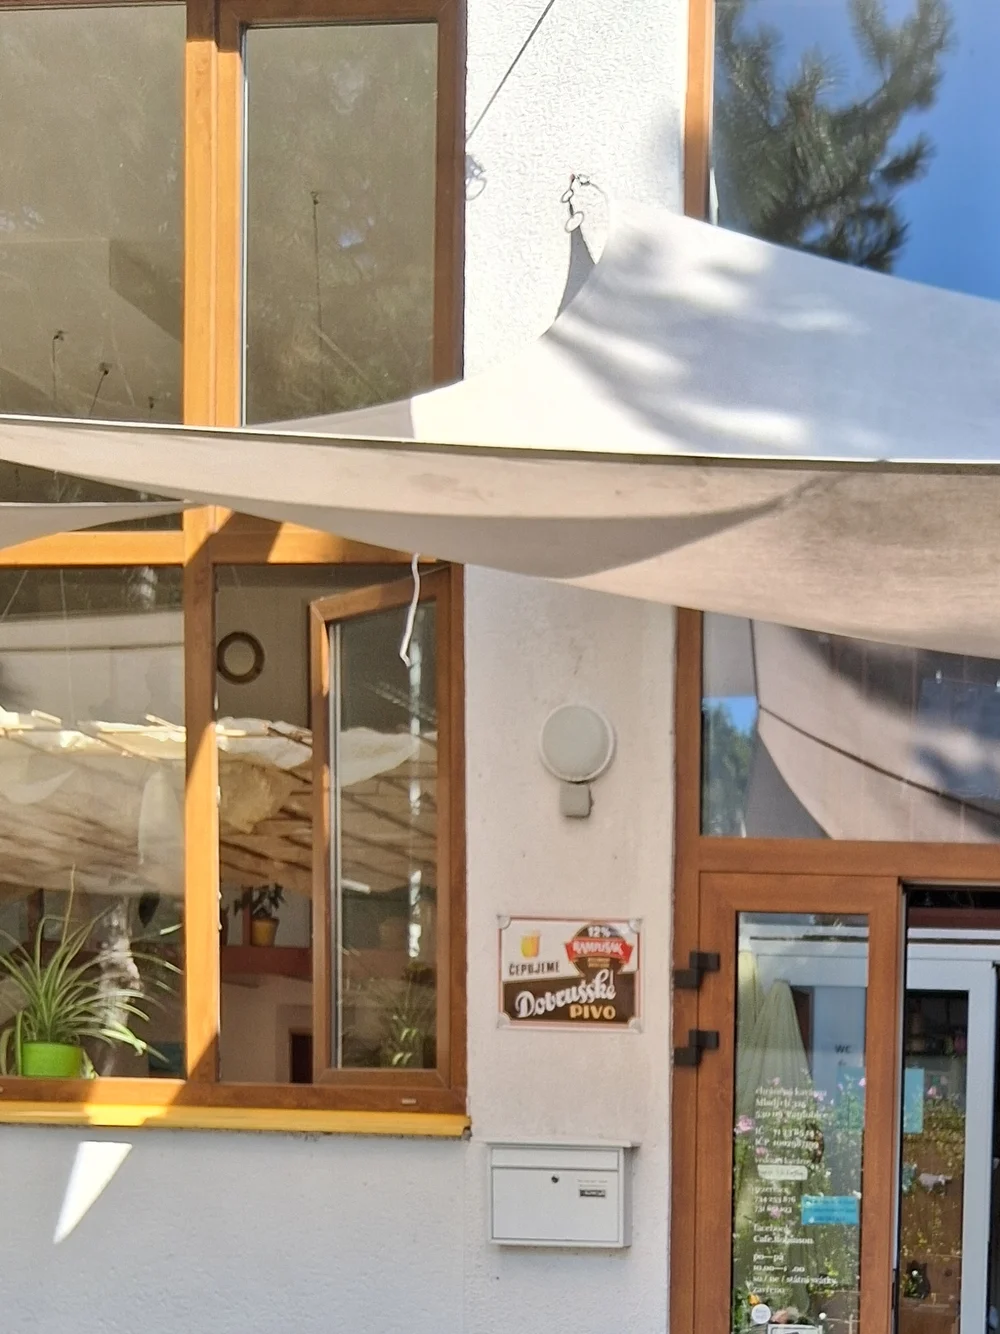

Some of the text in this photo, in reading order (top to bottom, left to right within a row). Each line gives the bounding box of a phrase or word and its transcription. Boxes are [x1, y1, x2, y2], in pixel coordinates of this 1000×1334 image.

[508, 960, 561, 976] ČEPUJEME
[569, 1004, 616, 1020] PIVO
[835, 1045, 852, 1054] WC
